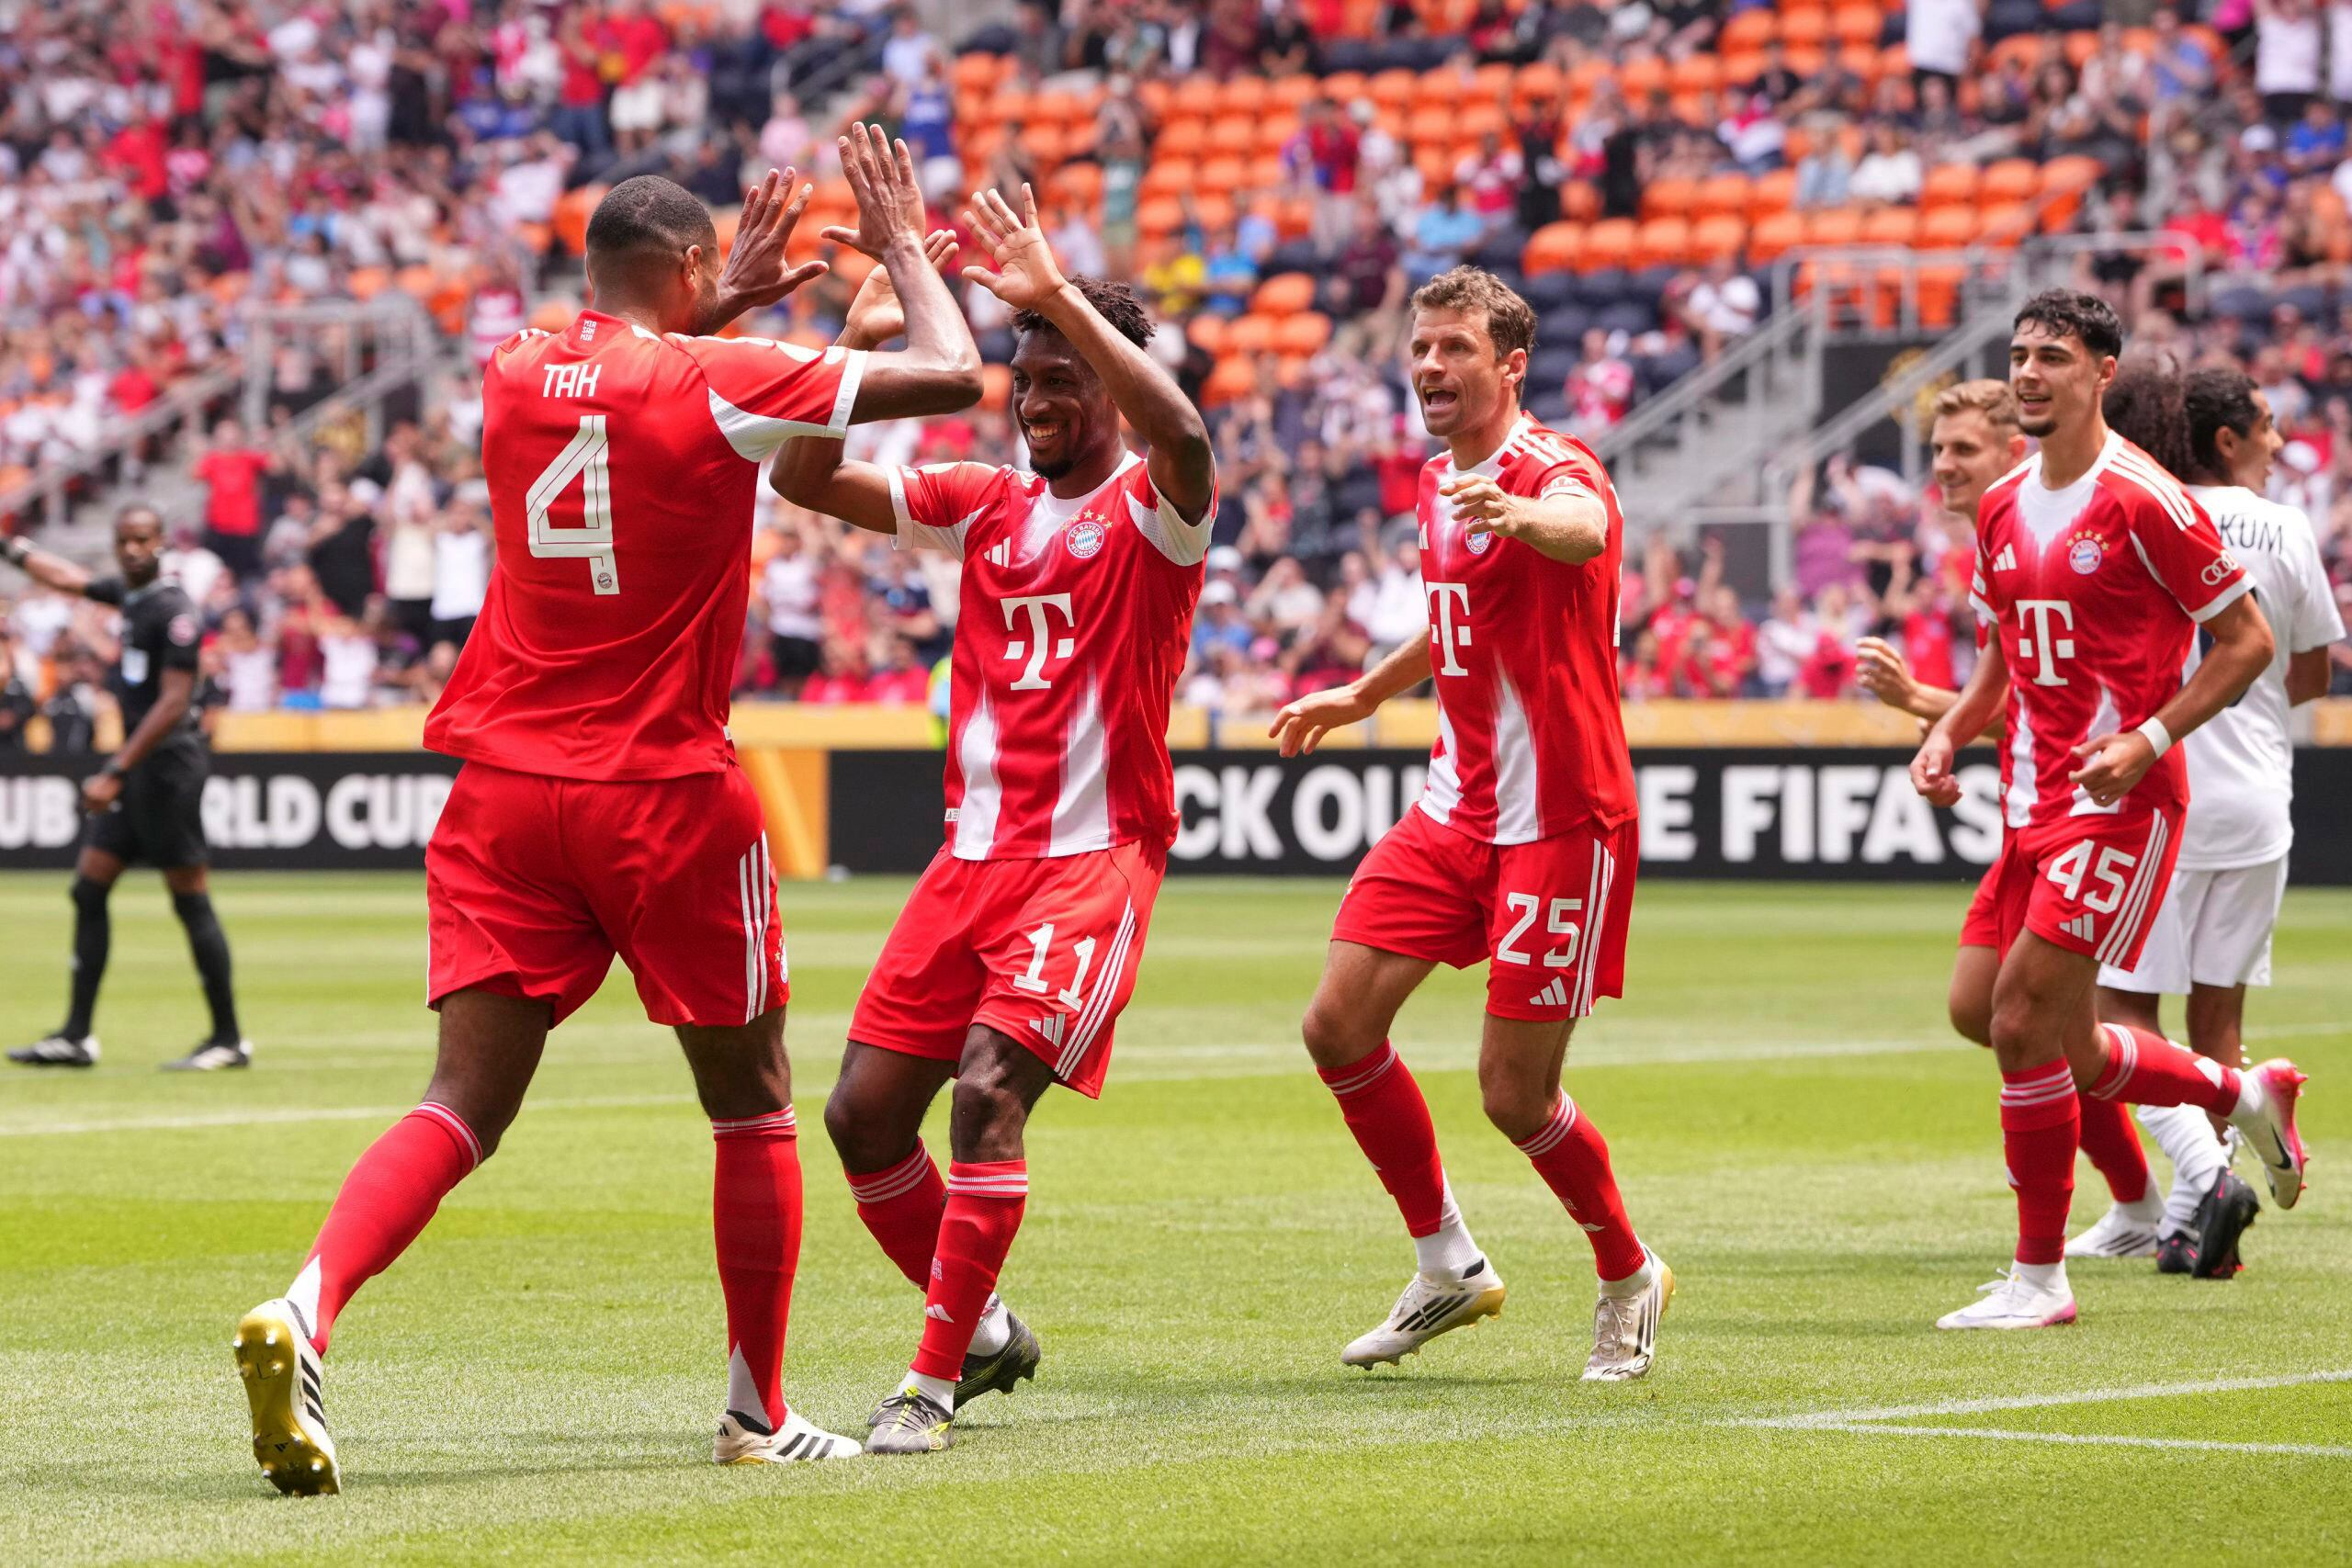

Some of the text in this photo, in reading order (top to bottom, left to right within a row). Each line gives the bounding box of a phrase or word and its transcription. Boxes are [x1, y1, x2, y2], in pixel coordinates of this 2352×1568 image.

[543, 364, 602, 398] TAH
[526, 414, 620, 595] 4
[2220, 513, 2282, 555] KUM
[1000, 592, 1075, 691] T
[1425, 581, 1472, 676] T
[2015, 599, 2075, 686] T
[2046, 838, 2137, 914] 45
[1012, 922, 1096, 1012] 11
[1497, 891, 1583, 967] 25
